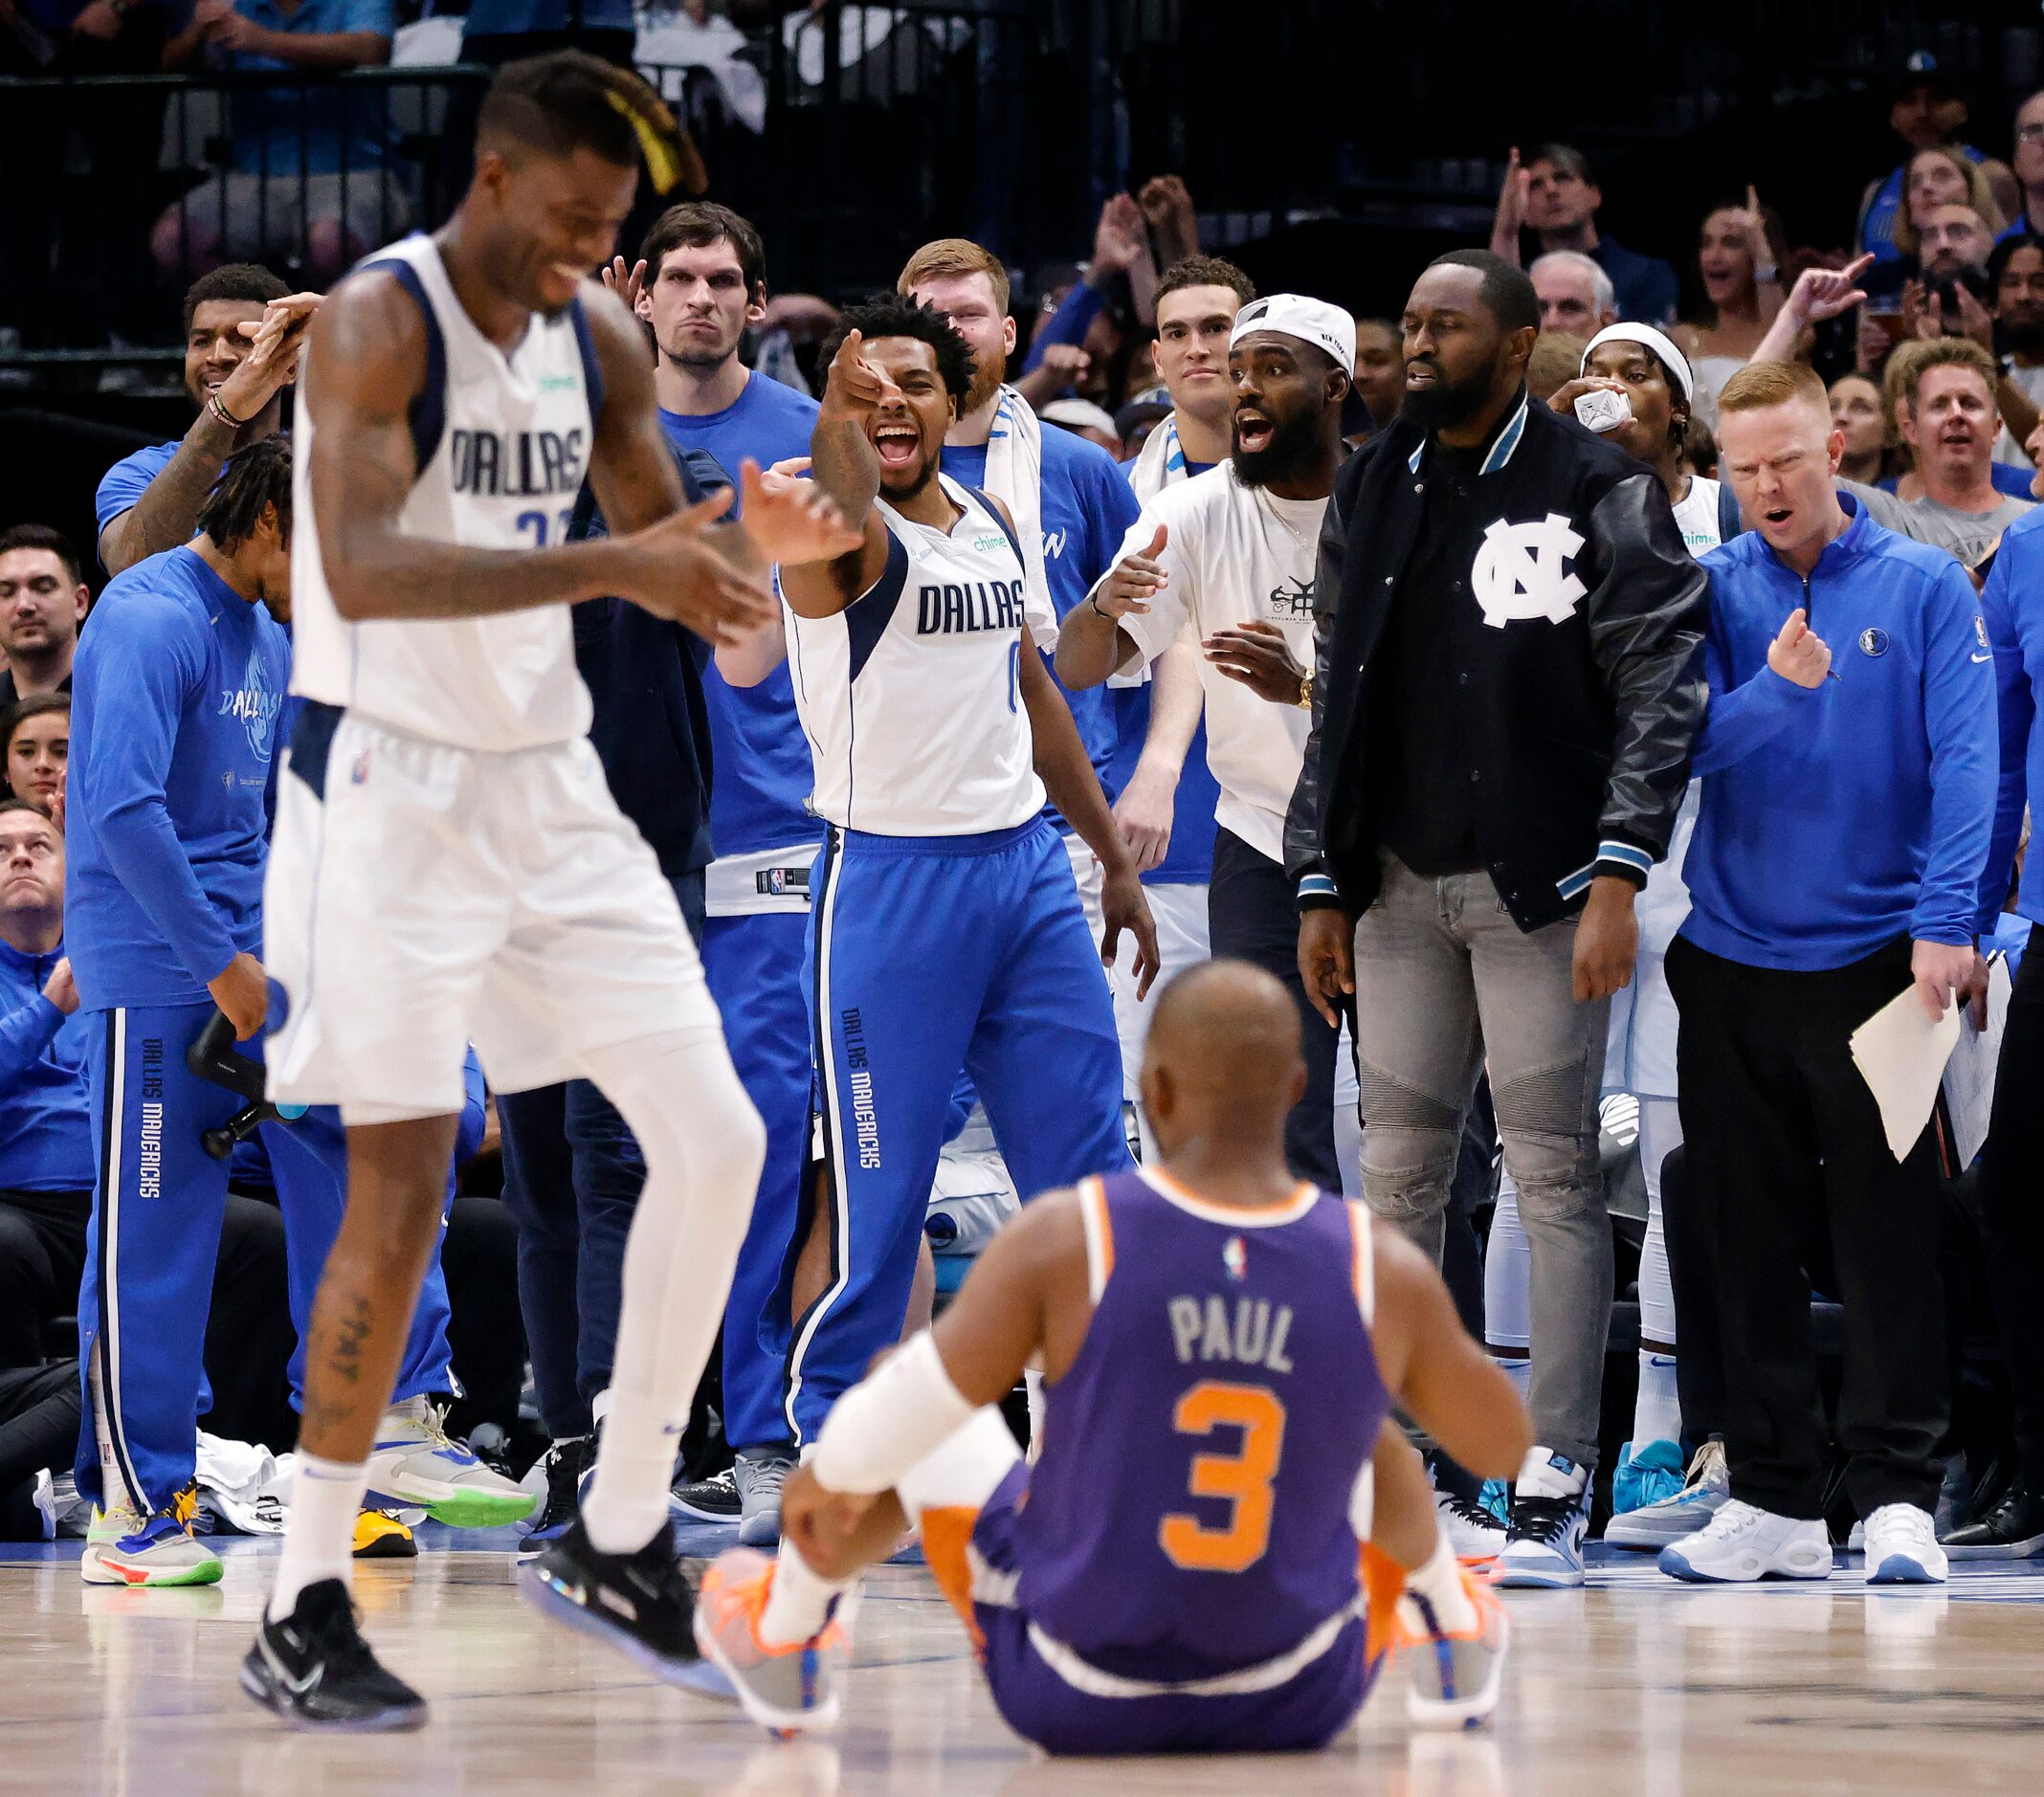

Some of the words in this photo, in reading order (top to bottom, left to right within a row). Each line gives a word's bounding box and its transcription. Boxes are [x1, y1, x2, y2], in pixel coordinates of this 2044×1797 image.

[1321, 333, 1333, 343] NEW
[1333, 339, 1345, 354] YORK
[452, 430, 584, 497] DALLAS
[973, 535, 1008, 552] chime
[915, 579, 1025, 635] DALLAS
[218, 689, 278, 720] DALLAS
[142, 1038, 164, 1098] DALLAS
[842, 1008, 869, 1069] DALLAS
[140, 1102, 164, 1199] MAVERICKS
[850, 1072, 881, 1169] MAVERICKS
[1166, 1295, 1294, 1374] PAUL
[1157, 1379, 1287, 1573] 3
